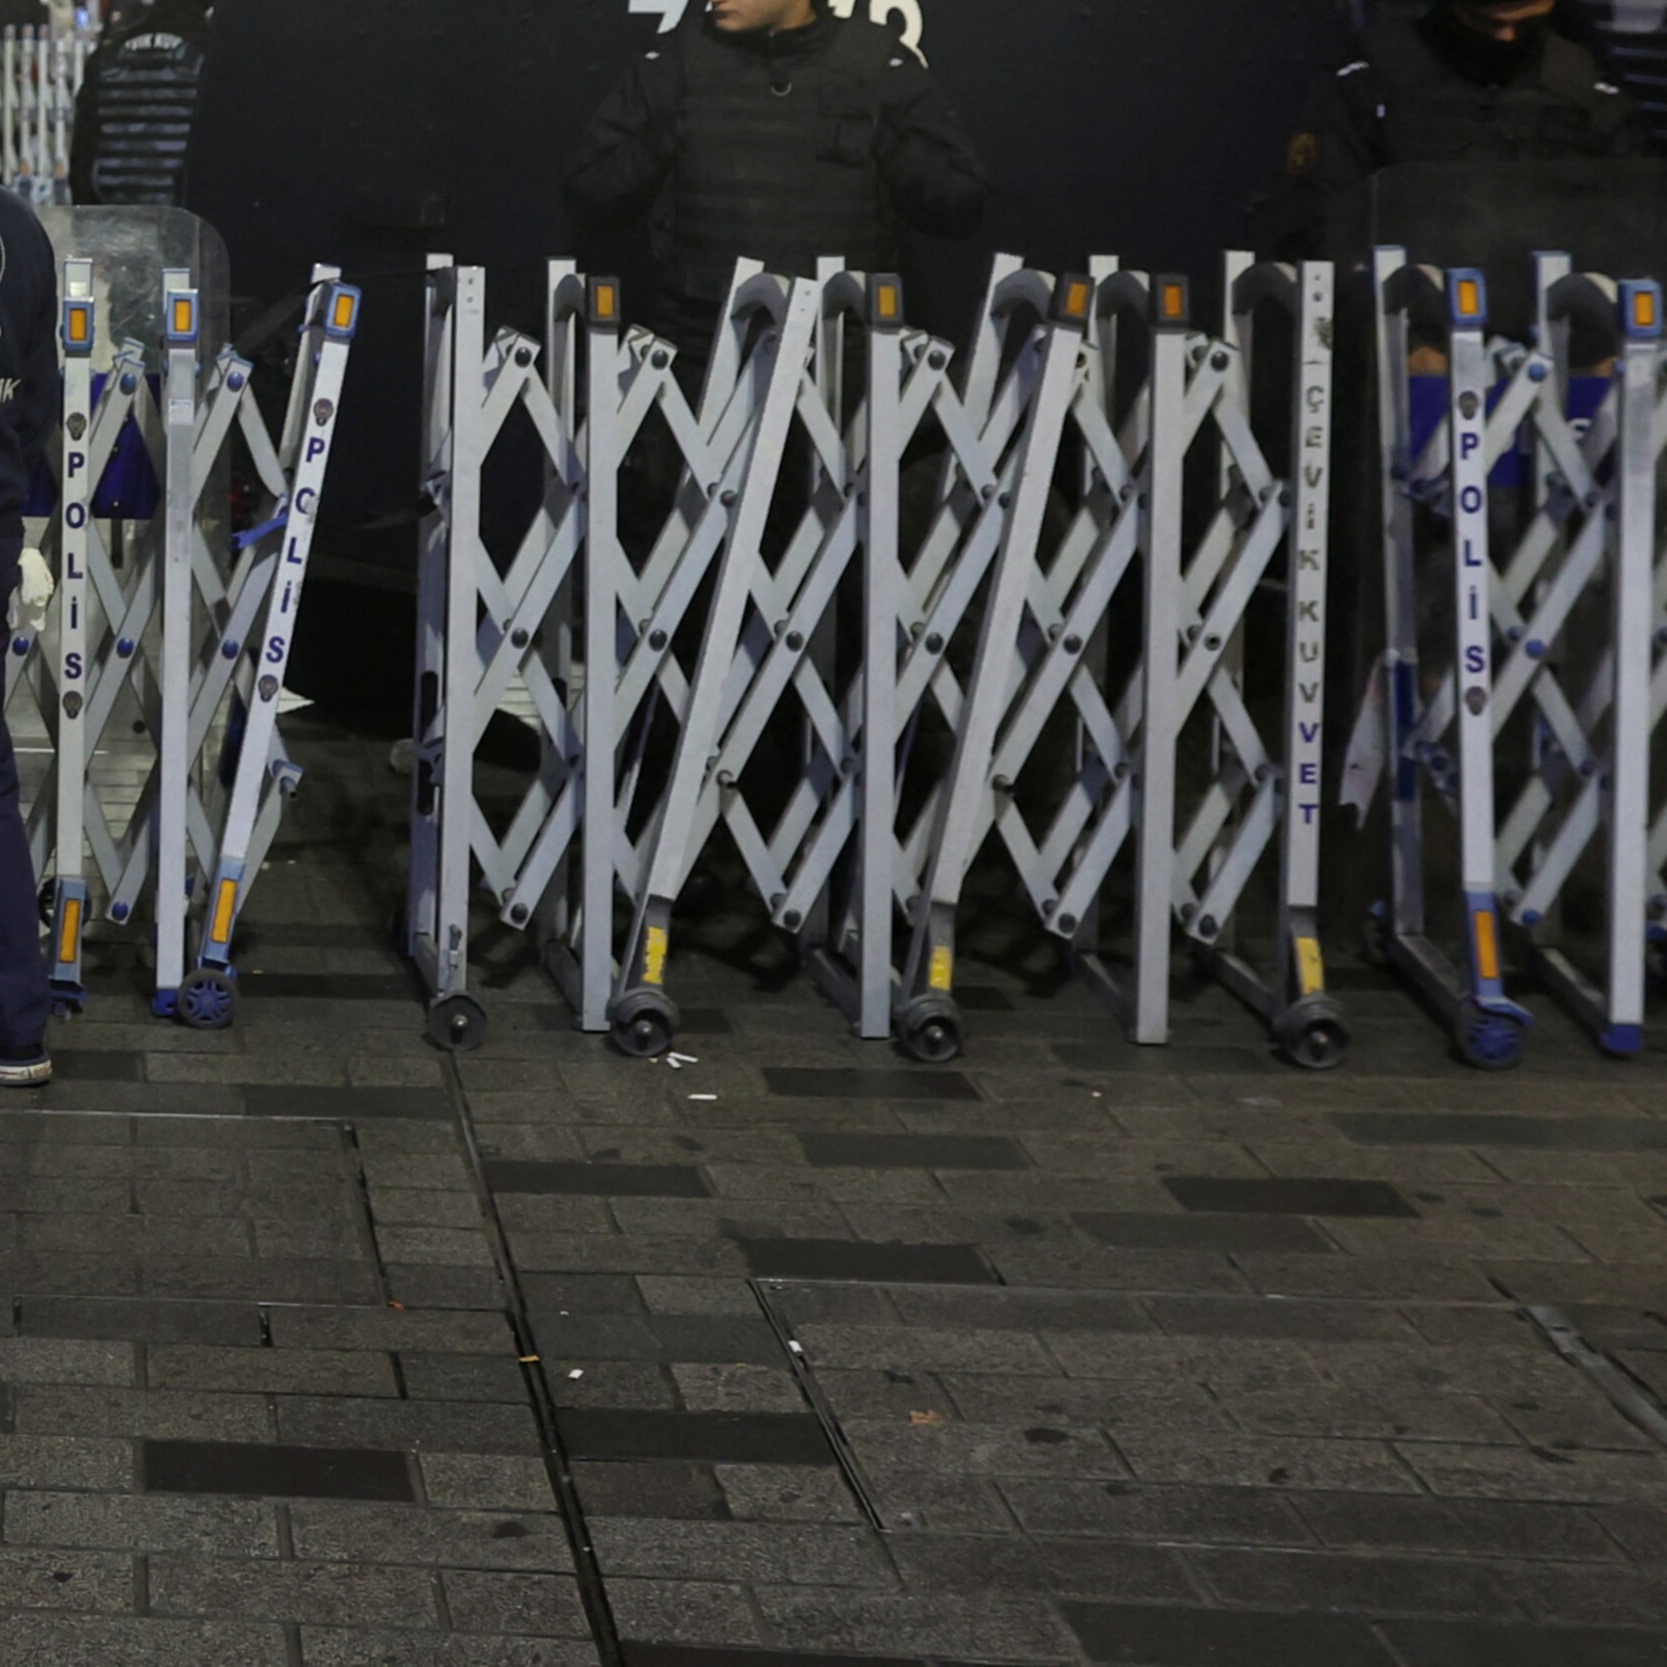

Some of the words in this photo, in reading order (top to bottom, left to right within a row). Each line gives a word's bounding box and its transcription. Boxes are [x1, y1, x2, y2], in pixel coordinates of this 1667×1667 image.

[64, 450, 86, 681] POLİS
[1299, 385, 1325, 573] ÇEVİK
[1459, 431, 1486, 675] POLİS
[1297, 599, 1320, 824] KUVVET
